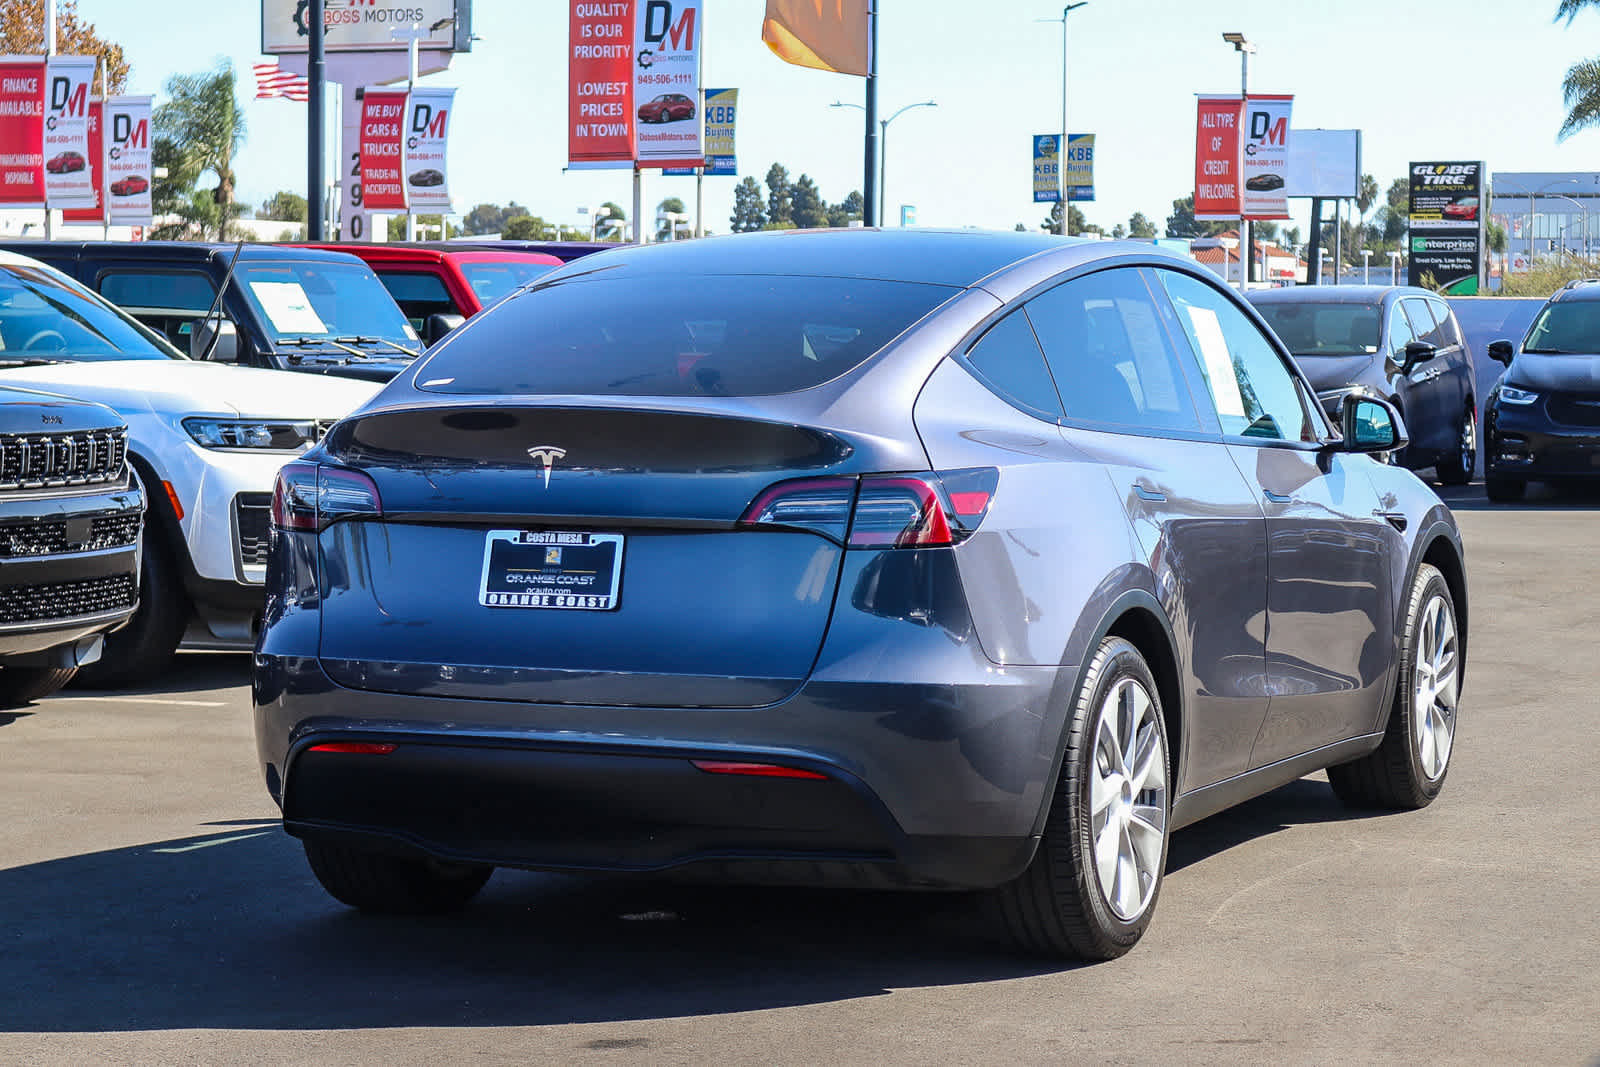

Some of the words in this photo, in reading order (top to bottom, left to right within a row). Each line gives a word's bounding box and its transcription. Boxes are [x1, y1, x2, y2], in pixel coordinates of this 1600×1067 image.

[305, 10, 360, 25] BOSS
[365, 8, 424, 22] MOTORS
[576, 3, 628, 18] QUALITY
[582, 24, 592, 37] IS
[595, 24, 623, 37] OUR
[644, 0, 696, 51] DM
[575, 45, 630, 58] PRIORITY
[2, 78, 37, 93] FINANCE
[637, 74, 692, 85] 949-506-1111
[577, 82, 628, 96] LOWEST
[51, 76, 88, 118] DM
[367, 105, 384, 116] WE
[383, 105, 402, 117] BUY
[580, 104, 623, 116] PRICES
[706, 107, 735, 123] KBB
[412, 104, 447, 138] DM
[1203, 113, 1215, 128] ALL
[1217, 113, 1234, 128] TYPE
[113, 113, 148, 149] DM
[366, 124, 389, 136] CARS
[391, 125, 399, 136] &
[576, 125, 590, 137] IN
[591, 124, 628, 137] TOWN
[706, 126, 735, 139] Buying
[1251, 111, 1287, 145] DM
[364, 143, 399, 155] TRUCKS
[1212, 137, 1222, 151] OF
[1068, 148, 1092, 161] KBB
[365, 169, 398, 179] TRADE-IN
[1204, 160, 1229, 175] CREDIT
[1413, 165, 1477, 175] GLOBE
[1424, 175, 1467, 185] TIRE
[365, 184, 400, 194] ACCEPTED
[1199, 184, 1235, 199] WELCOME
[1415, 240, 1475, 250] enterprise
[527, 533, 556, 542] COSTA
[557, 534, 582, 543] MESA
[506, 574, 555, 584] ORANGE
[556, 575, 596, 585] COAST
[526, 587, 572, 595] ocauto.com
[489, 594, 549, 605] ORANGE
[556, 596, 607, 607] COAST
